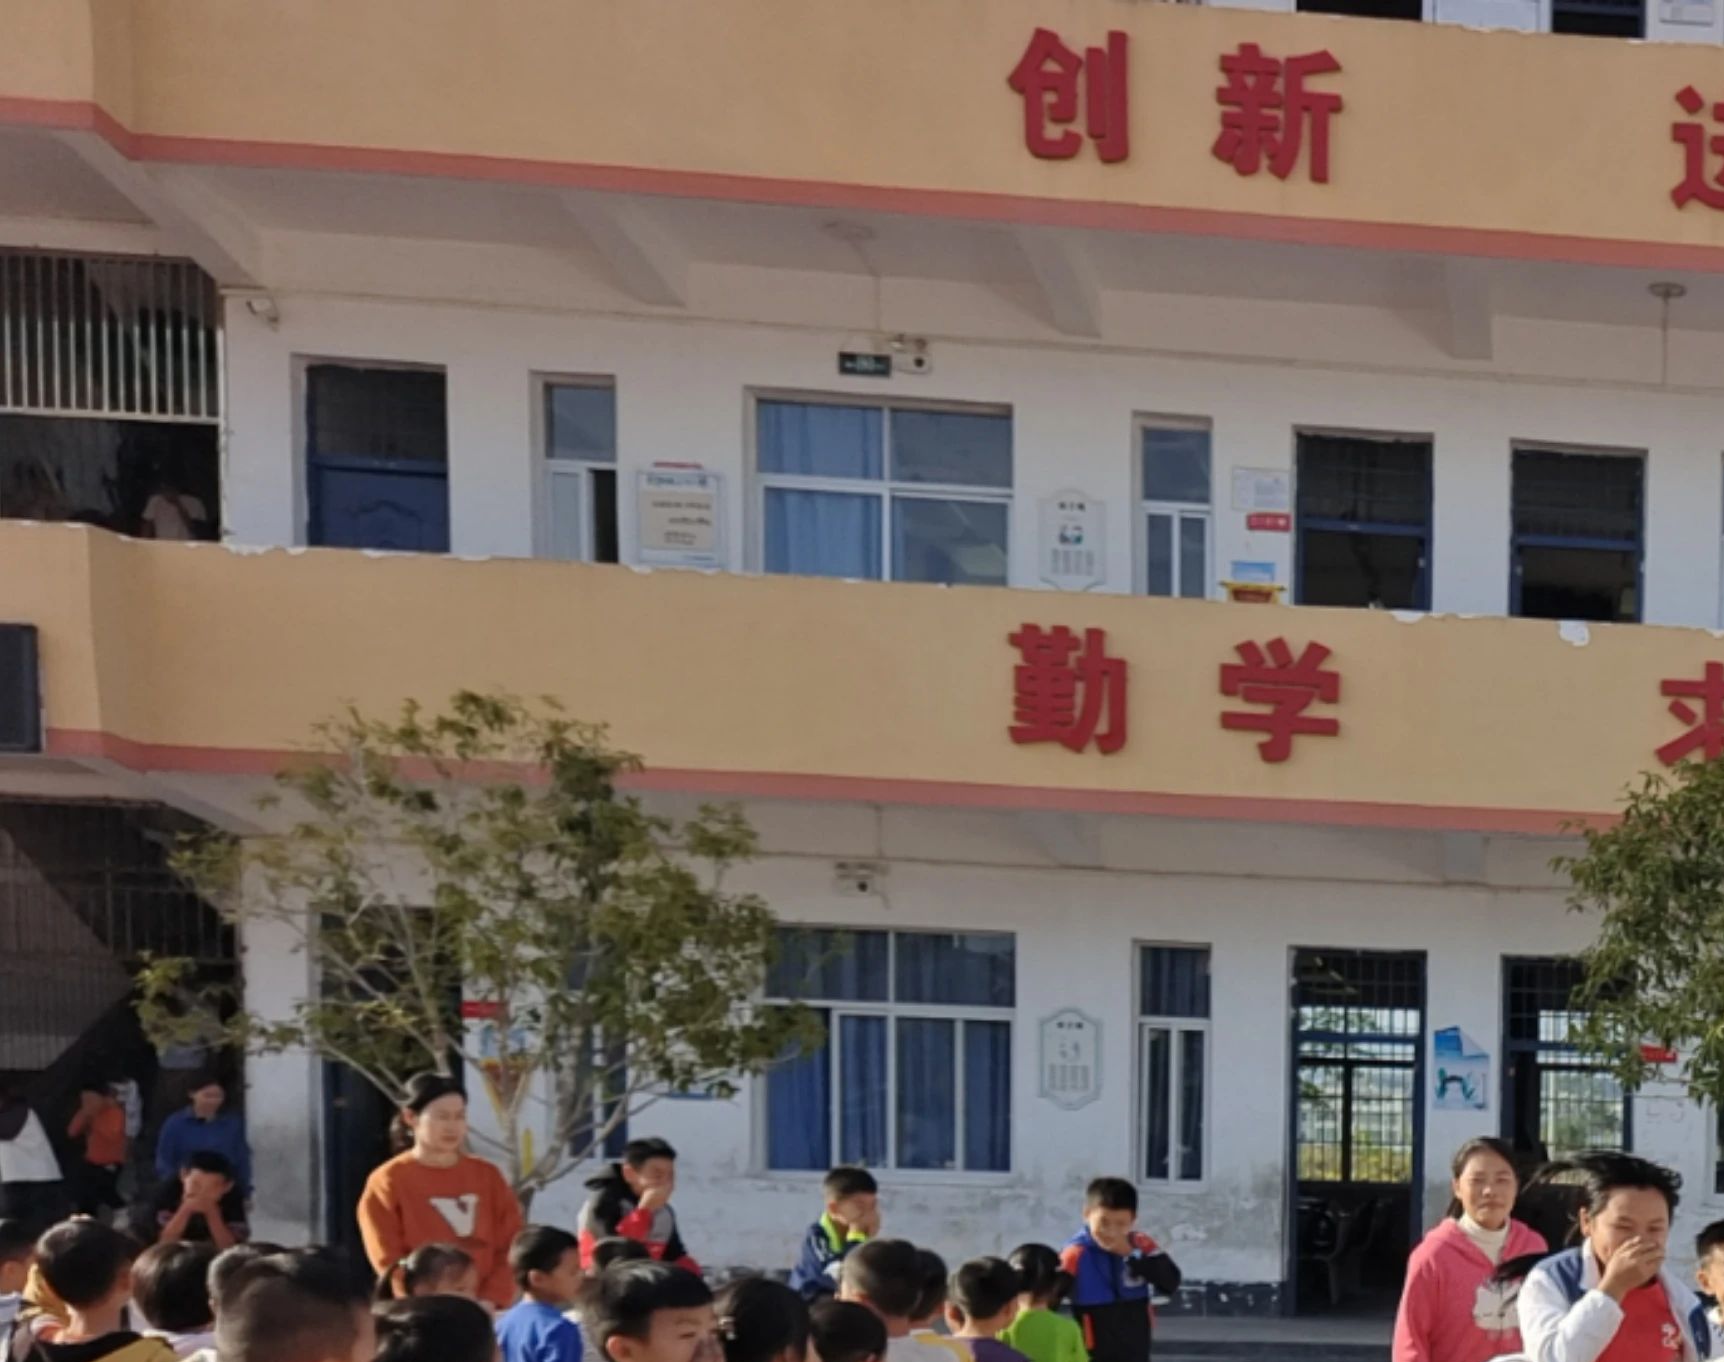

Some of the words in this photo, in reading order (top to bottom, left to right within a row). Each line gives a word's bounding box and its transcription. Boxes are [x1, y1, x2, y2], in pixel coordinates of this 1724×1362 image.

[1007, 27, 1342, 184] 创新
[1007, 622, 1341, 763] 勤学
[429, 1193, 479, 1238] V
